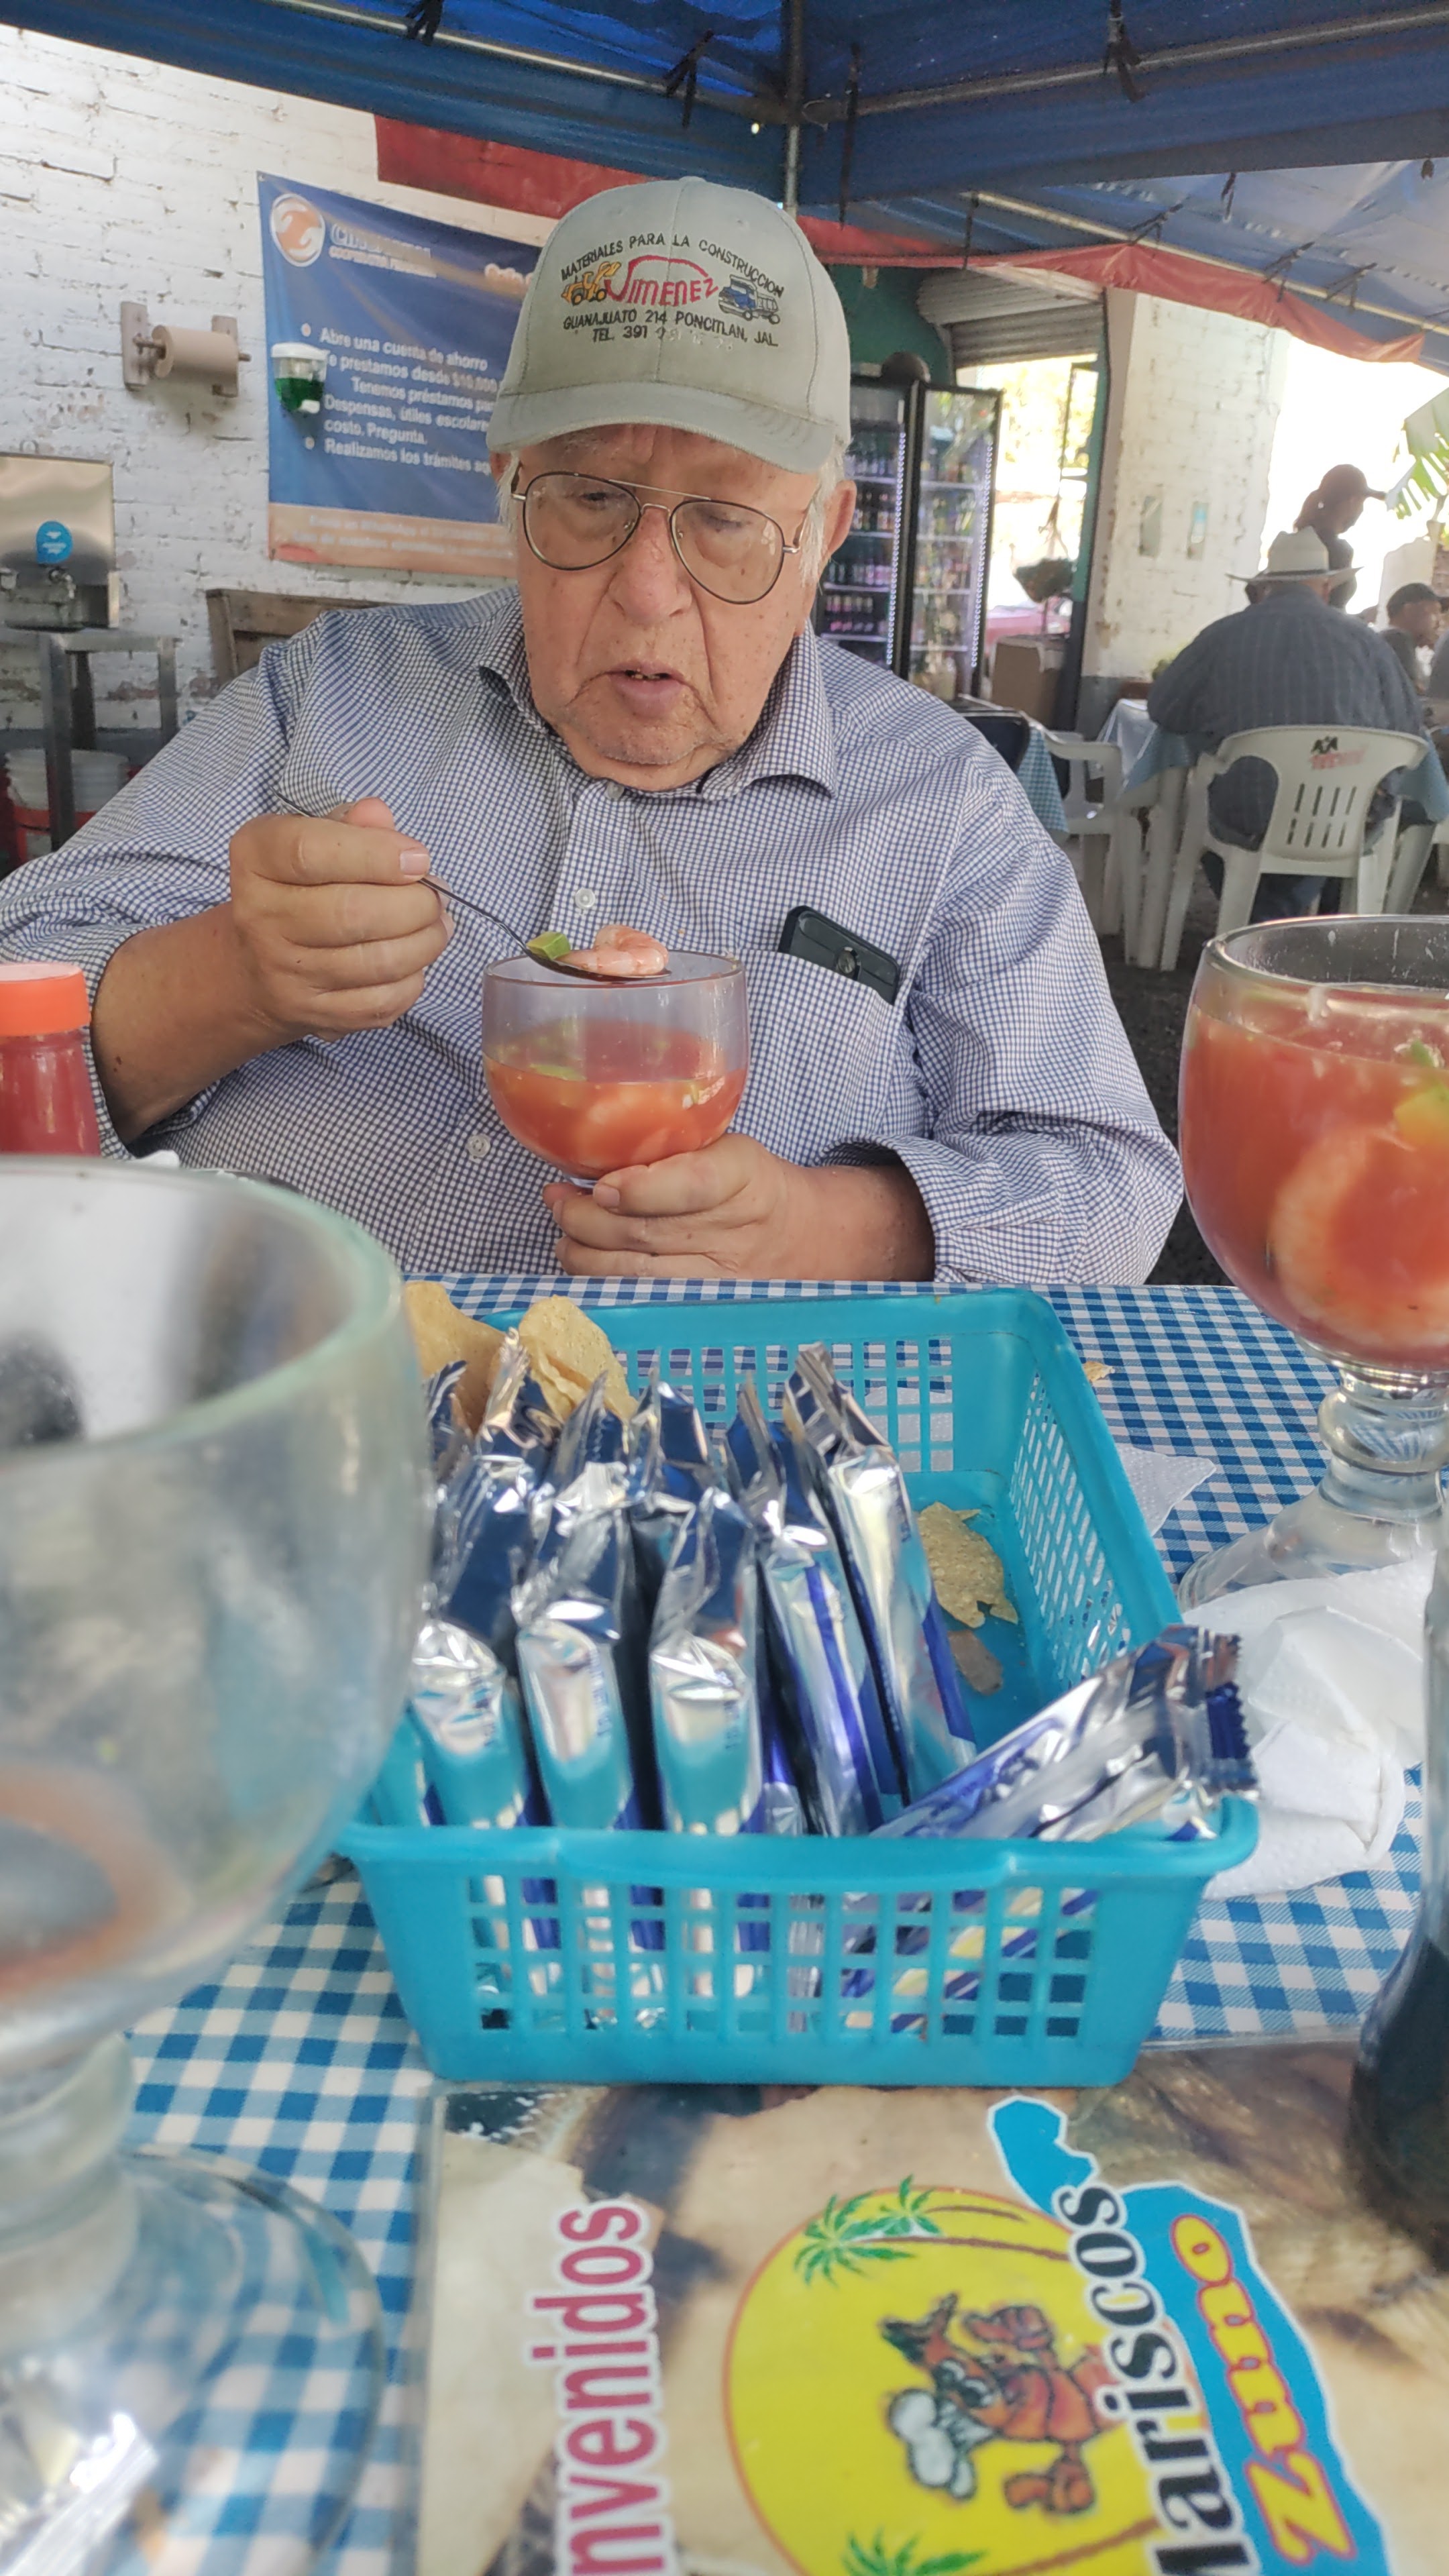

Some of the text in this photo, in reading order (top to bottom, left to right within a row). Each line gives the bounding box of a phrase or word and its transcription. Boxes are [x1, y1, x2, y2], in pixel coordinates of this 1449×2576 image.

[561, 240, 624, 281] MATERIALES
[629, 232, 666, 249] PARA
[672, 233, 690, 248] LA
[698, 239, 784, 299] CONSTRUCCION
[563, 309, 637, 330] GUANAJUATO
[645, 309, 667, 325] 214
[623, 325, 647, 339] 391
[319, 327, 488, 372] Abre una cuenta de ahorro
[351, 376, 407, 400] Tenemos
[435, 414, 490, 432] escolare
[324, 437, 398, 462] Realizamos
[400, 447, 421, 465] los
